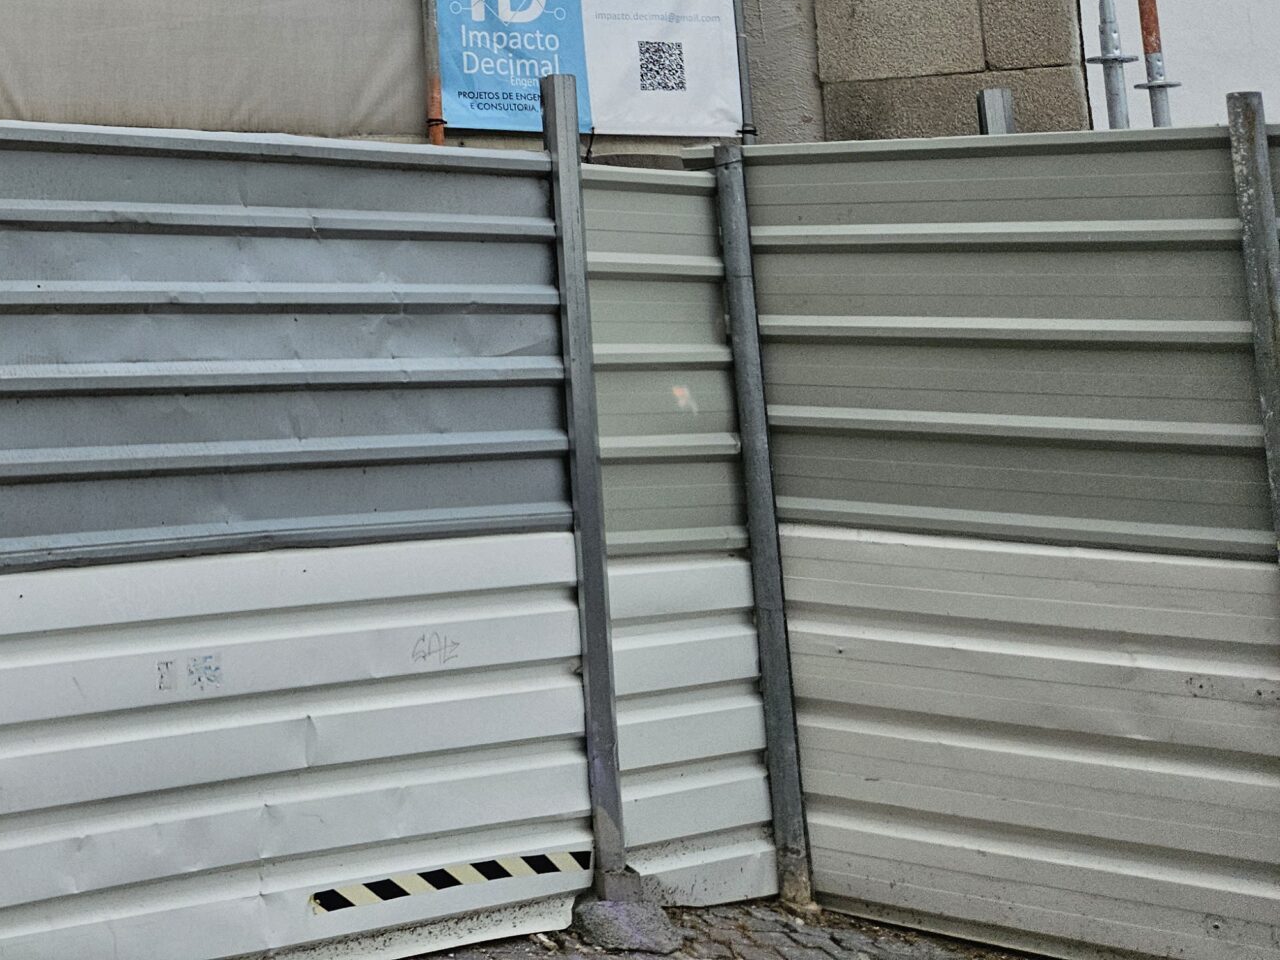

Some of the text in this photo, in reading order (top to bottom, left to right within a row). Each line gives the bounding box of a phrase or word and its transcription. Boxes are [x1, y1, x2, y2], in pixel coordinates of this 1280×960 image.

[461, 24, 560, 54] Impacto
[463, 51, 560, 77] Decimal
[510, 76, 540, 89] Engen
[458, 91, 500, 100] PROJETOS
[502, 92, 514, 100] DE
